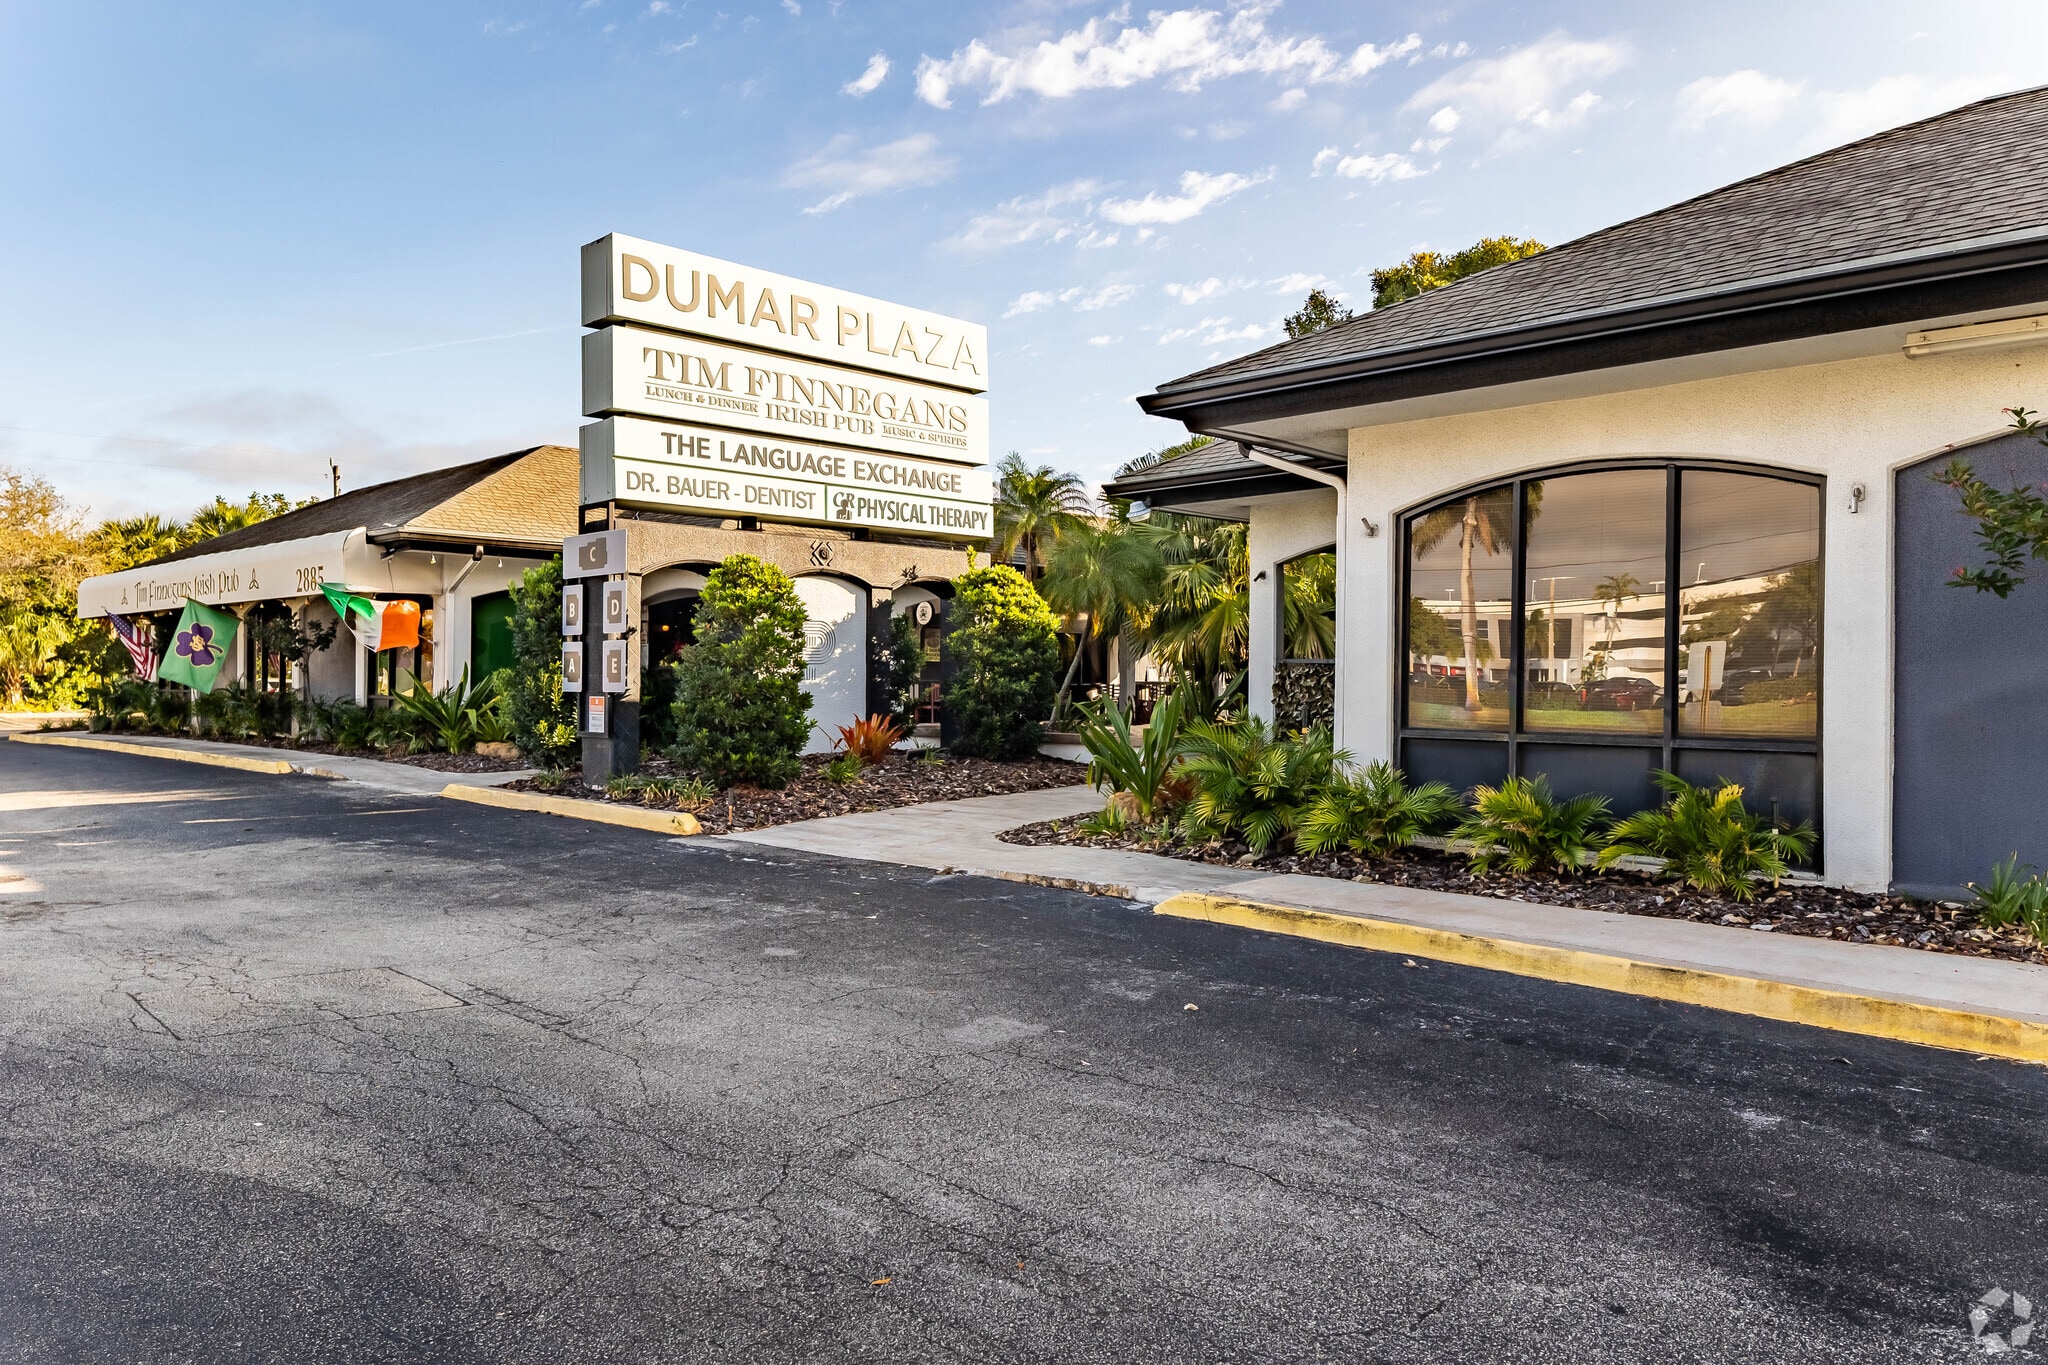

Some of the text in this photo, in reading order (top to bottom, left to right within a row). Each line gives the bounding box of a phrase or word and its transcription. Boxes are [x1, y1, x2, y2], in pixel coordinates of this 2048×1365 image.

[622, 253, 980, 376] DUMAR PLAZA
[643, 347, 968, 433] TIM FINNEGANS
[645, 385, 759, 413] LUNCH & DINNER
[765, 402, 875, 435] IRISH PUB
[883, 425, 916, 439] MUSIC
[928, 433, 967, 447] SPIRITS
[661, 432, 962, 493] THE LANGUAGE EXCHANGE
[626, 470, 660, 493] DR.
[667, 475, 730, 500] BAUER
[745, 485, 816, 510] DENTIST
[858, 497, 988, 530] PHYSICAL THERAPY
[589, 546, 596, 562] C
[218, 568, 239, 600] Pub
[296, 565, 324, 592] 2885
[569, 603, 575, 617] B
[611, 599, 619, 616] D
[568, 658, 575, 673] A
[611, 657, 618, 673] E
